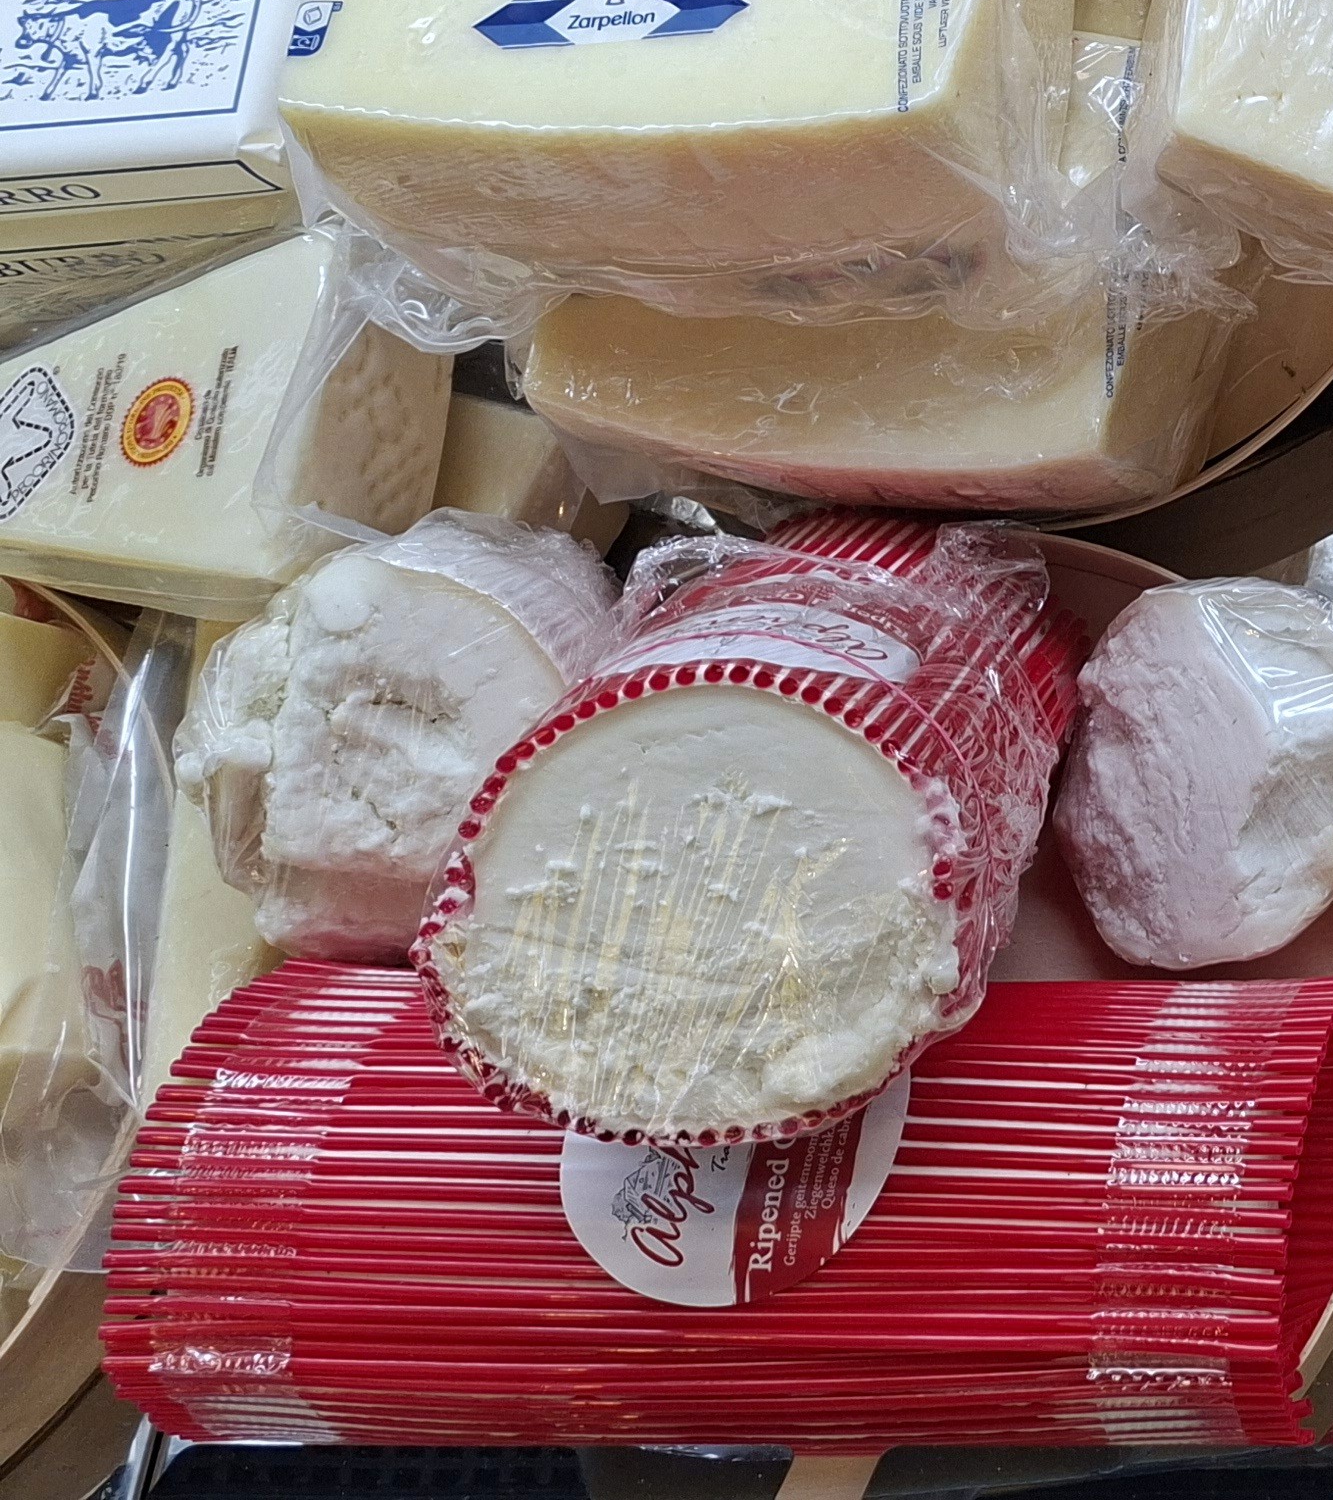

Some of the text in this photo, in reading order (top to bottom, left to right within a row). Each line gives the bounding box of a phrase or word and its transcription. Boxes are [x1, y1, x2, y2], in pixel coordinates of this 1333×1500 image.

[567, 11, 656, 31] Zarpellon
[11, 432, 68, 501] PECORINO
[749, 1158, 790, 1273] Ripened
[821, 1166, 839, 1210] Queso
[784, 1211, 803, 1267] Gerijpte
